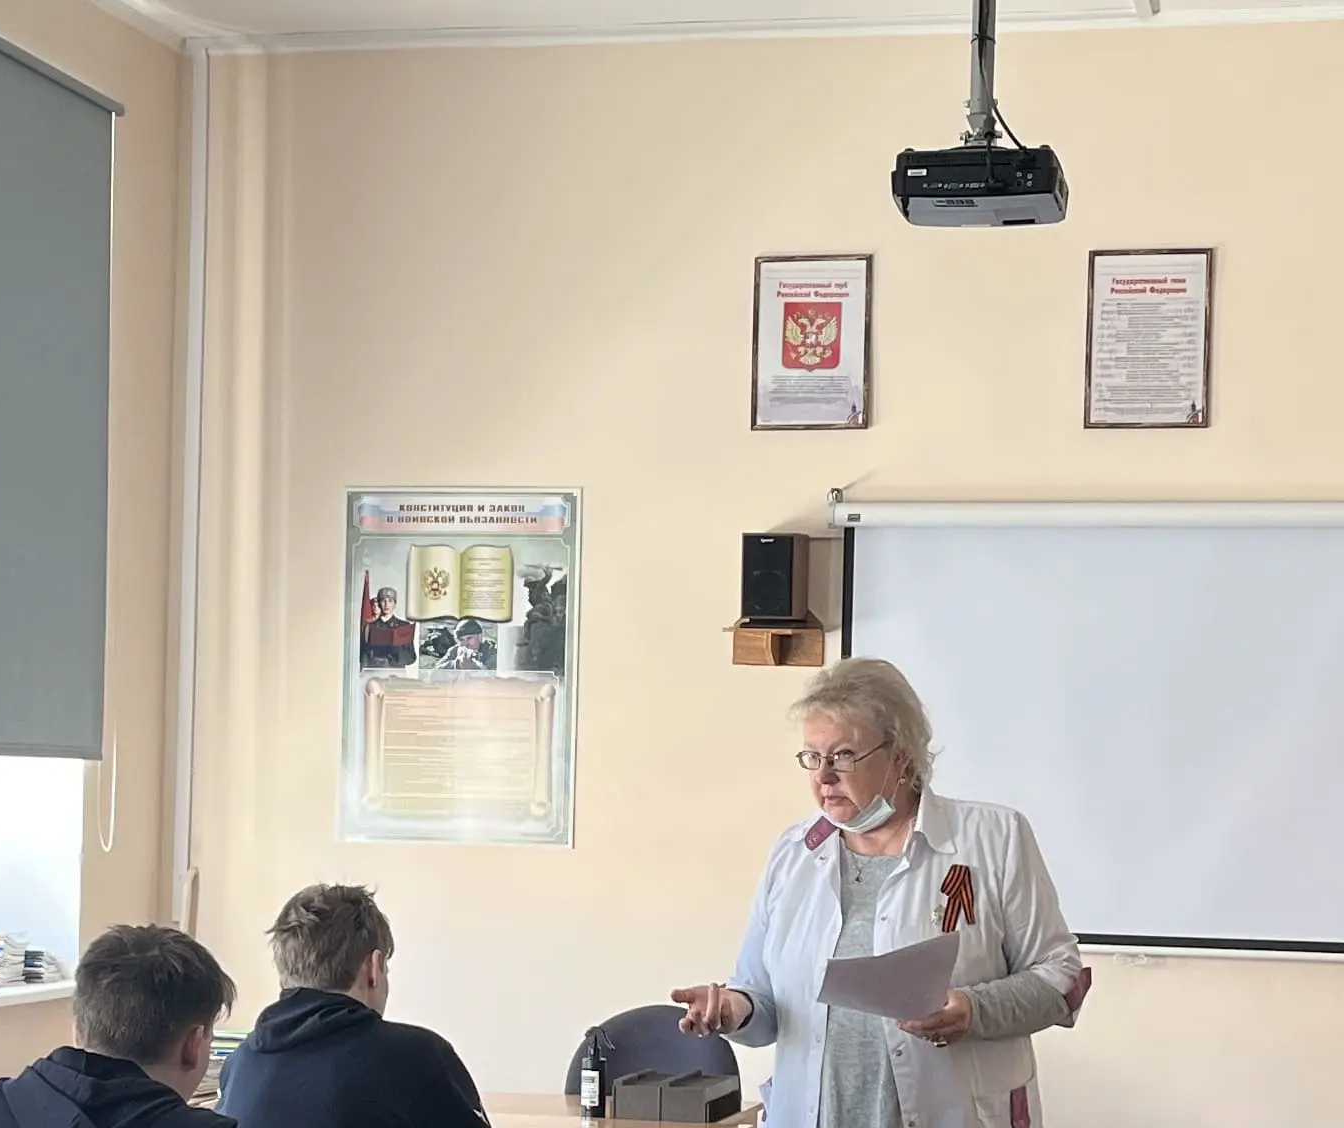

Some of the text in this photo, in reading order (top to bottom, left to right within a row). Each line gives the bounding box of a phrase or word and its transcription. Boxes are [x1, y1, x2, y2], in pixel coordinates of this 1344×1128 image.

[399, 504, 525, 513] КОНСТИТУЦИЯ И ЗАКОН
[397, 514, 455, 524] ВОИНСКОЙ
[459, 515, 537, 524] ОБЯЗАННОСТИ
